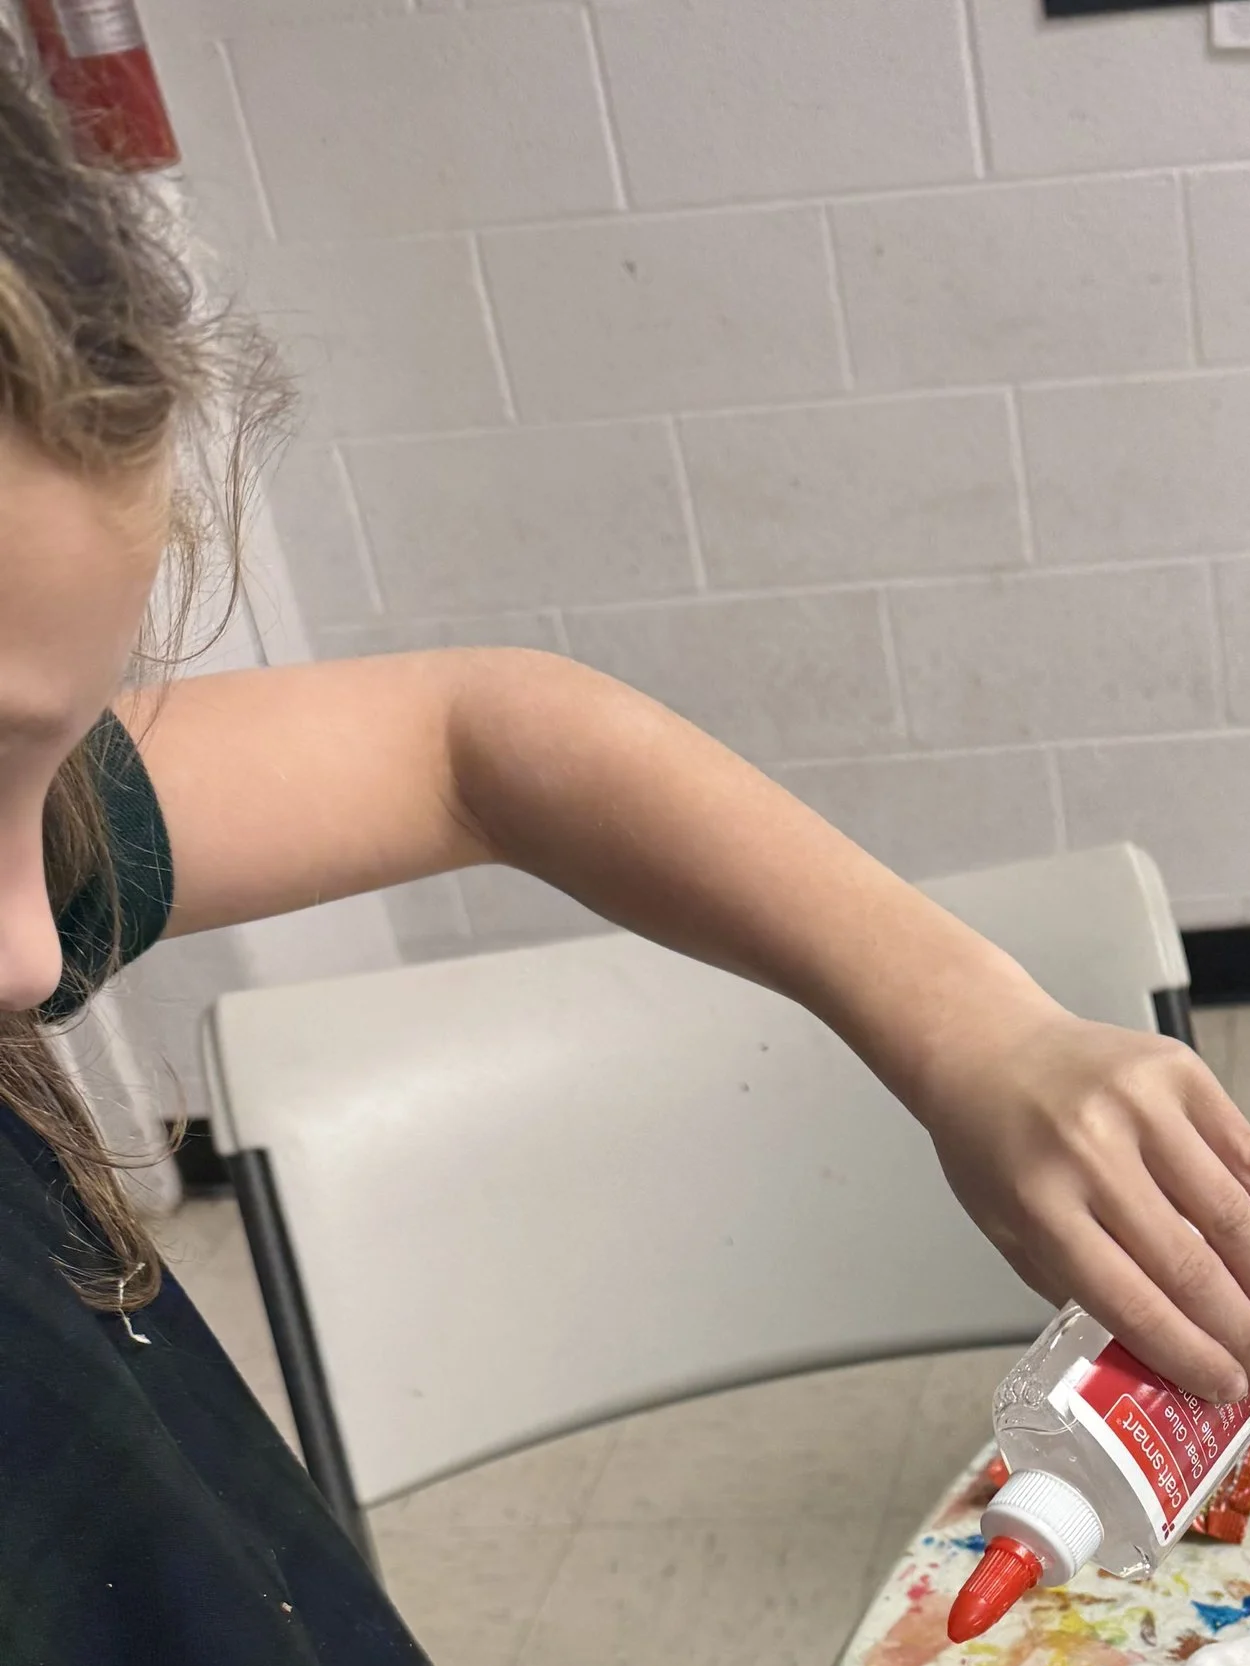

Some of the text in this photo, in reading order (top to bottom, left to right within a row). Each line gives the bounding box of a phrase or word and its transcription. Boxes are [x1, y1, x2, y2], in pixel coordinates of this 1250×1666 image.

[1164, 1405, 1203, 1479] Clear Glue
[1201, 1421, 1218, 1459] Colle
